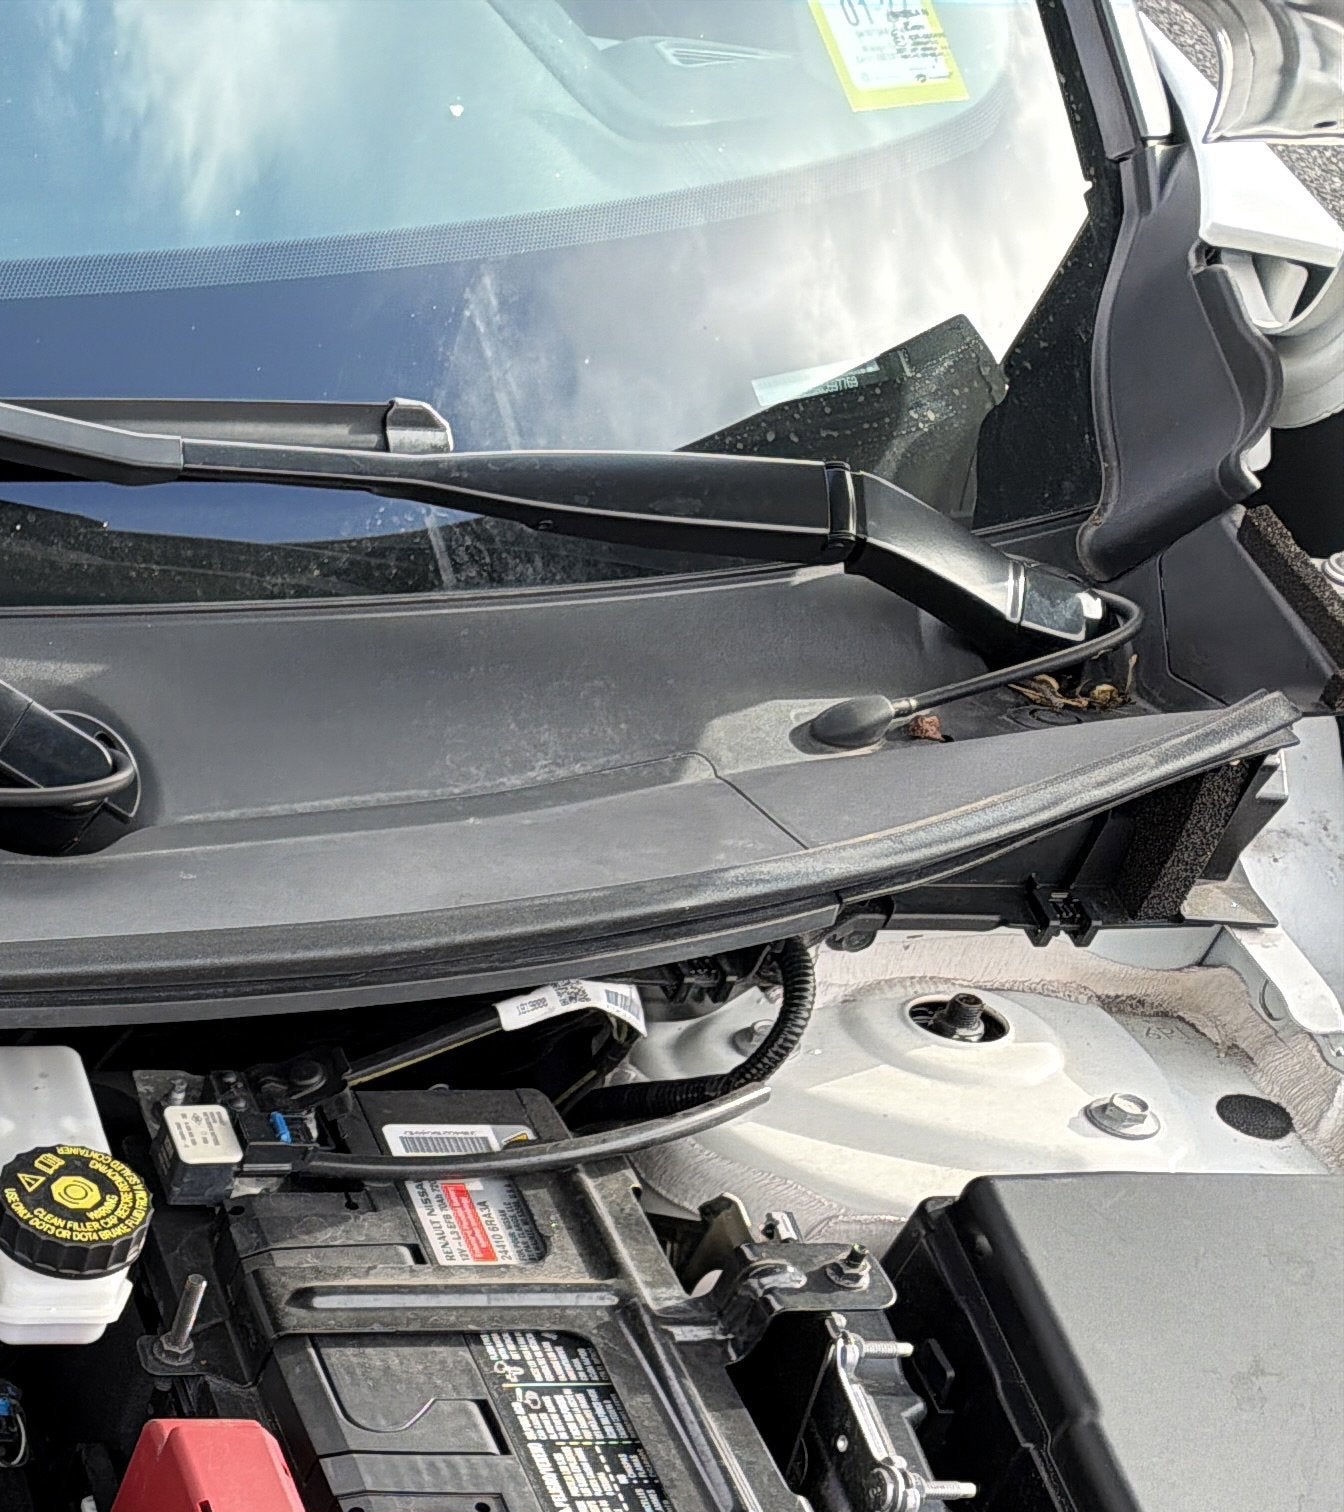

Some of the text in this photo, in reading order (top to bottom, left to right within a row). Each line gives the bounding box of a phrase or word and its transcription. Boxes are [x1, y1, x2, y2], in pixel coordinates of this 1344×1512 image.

[56, 1146, 112, 1164] CONTAINER
[110, 1160, 141, 1185] SEALED
[4, 1188, 17, 1203] USE
[34, 1160, 133, 1231] CLEAN FILLER CAP BEFORE REMOVING
[12, 1201, 33, 1220] ONLY
[86, 1194, 118, 1220] WARNING
[29, 1218, 56, 1234] DOT3
[125, 1210, 146, 1229] FLUID
[412, 1180, 456, 1260] RENAULT NISSA
[442, 1214, 456, 1228] EFB
[56, 1228, 71, 1239] OR
[73, 1232, 99, 1241] DOT4
[99, 1223, 132, 1240] BRAKE
[475, 1200, 512, 1260] 24410 6RA3A
[456, 1248, 470, 1260] 12V
